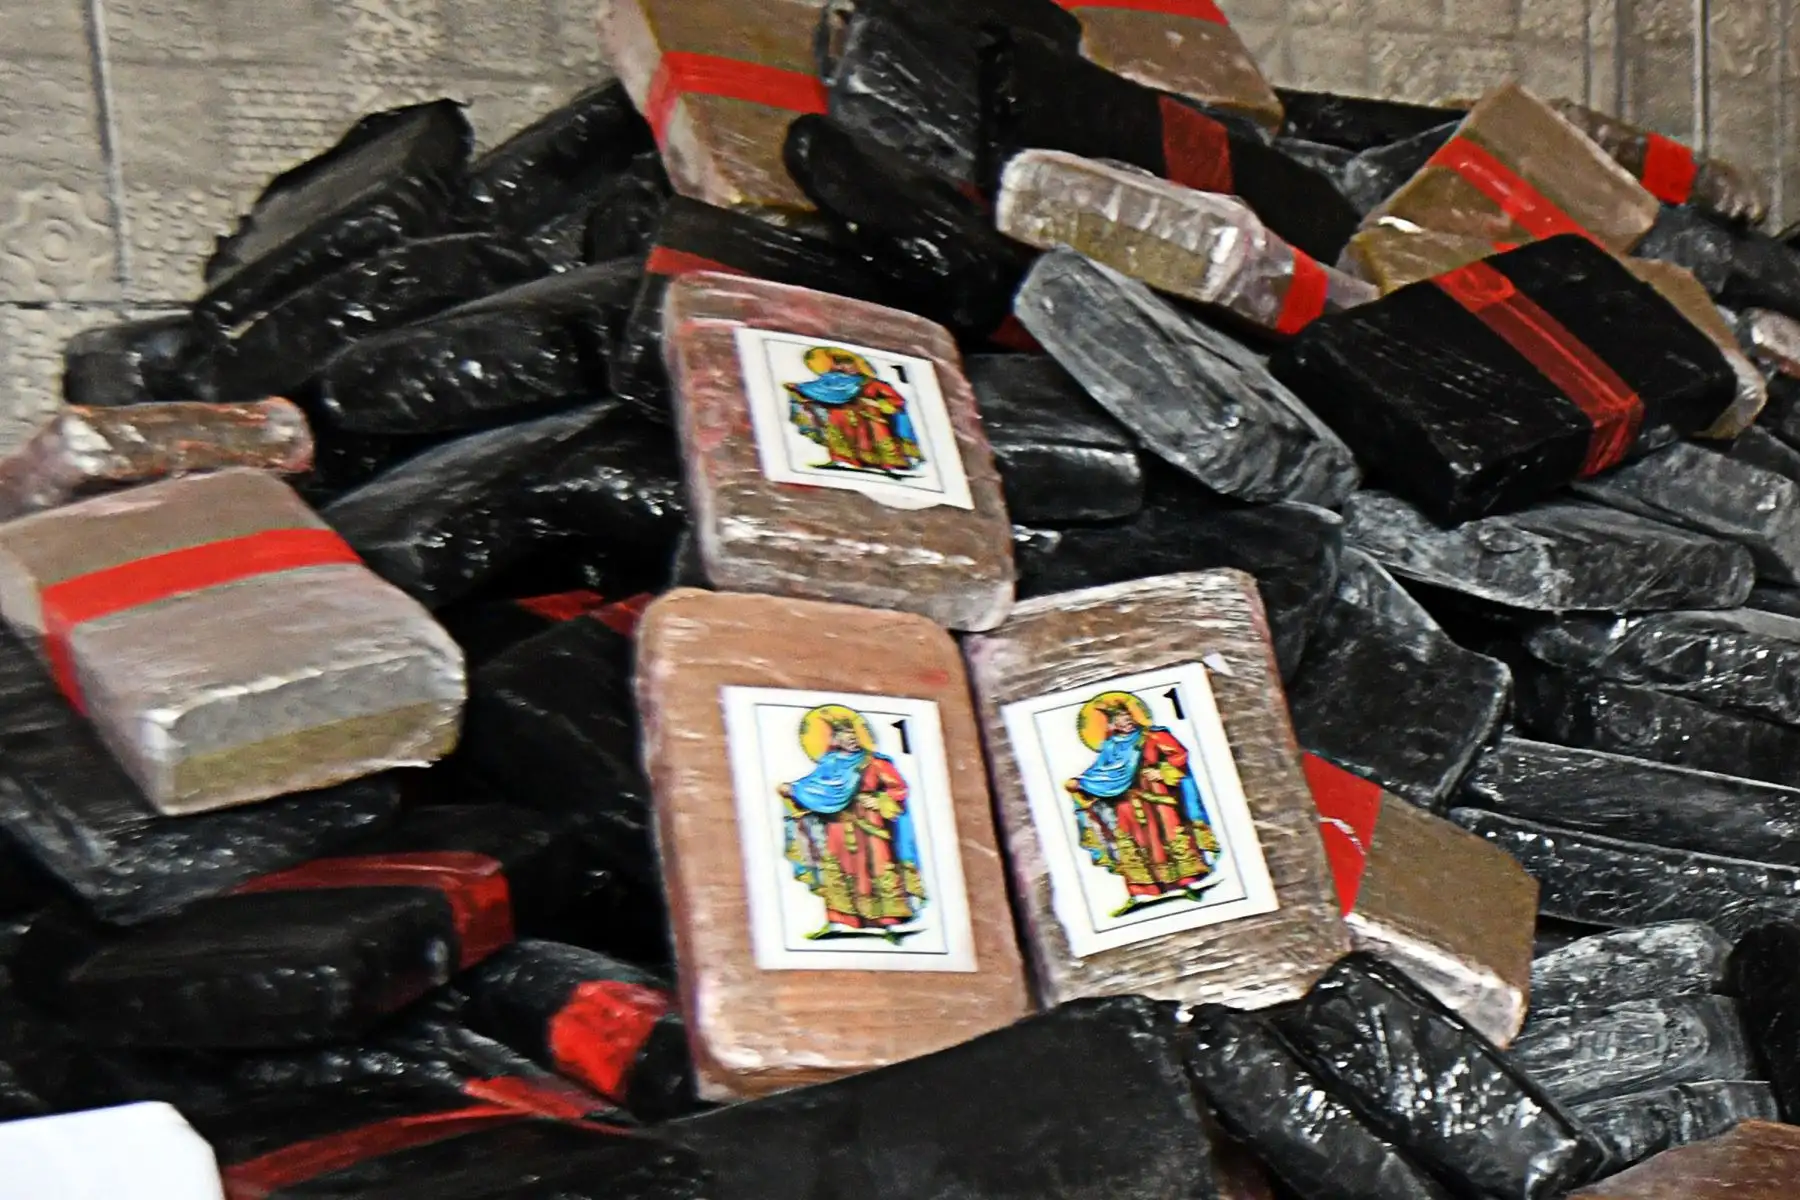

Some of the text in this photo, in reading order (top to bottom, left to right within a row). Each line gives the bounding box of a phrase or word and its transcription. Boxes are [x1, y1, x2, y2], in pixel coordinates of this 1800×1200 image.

[890, 365, 909, 384] 1
[1163, 687, 1185, 721] 1
[890, 719, 911, 755] 1
